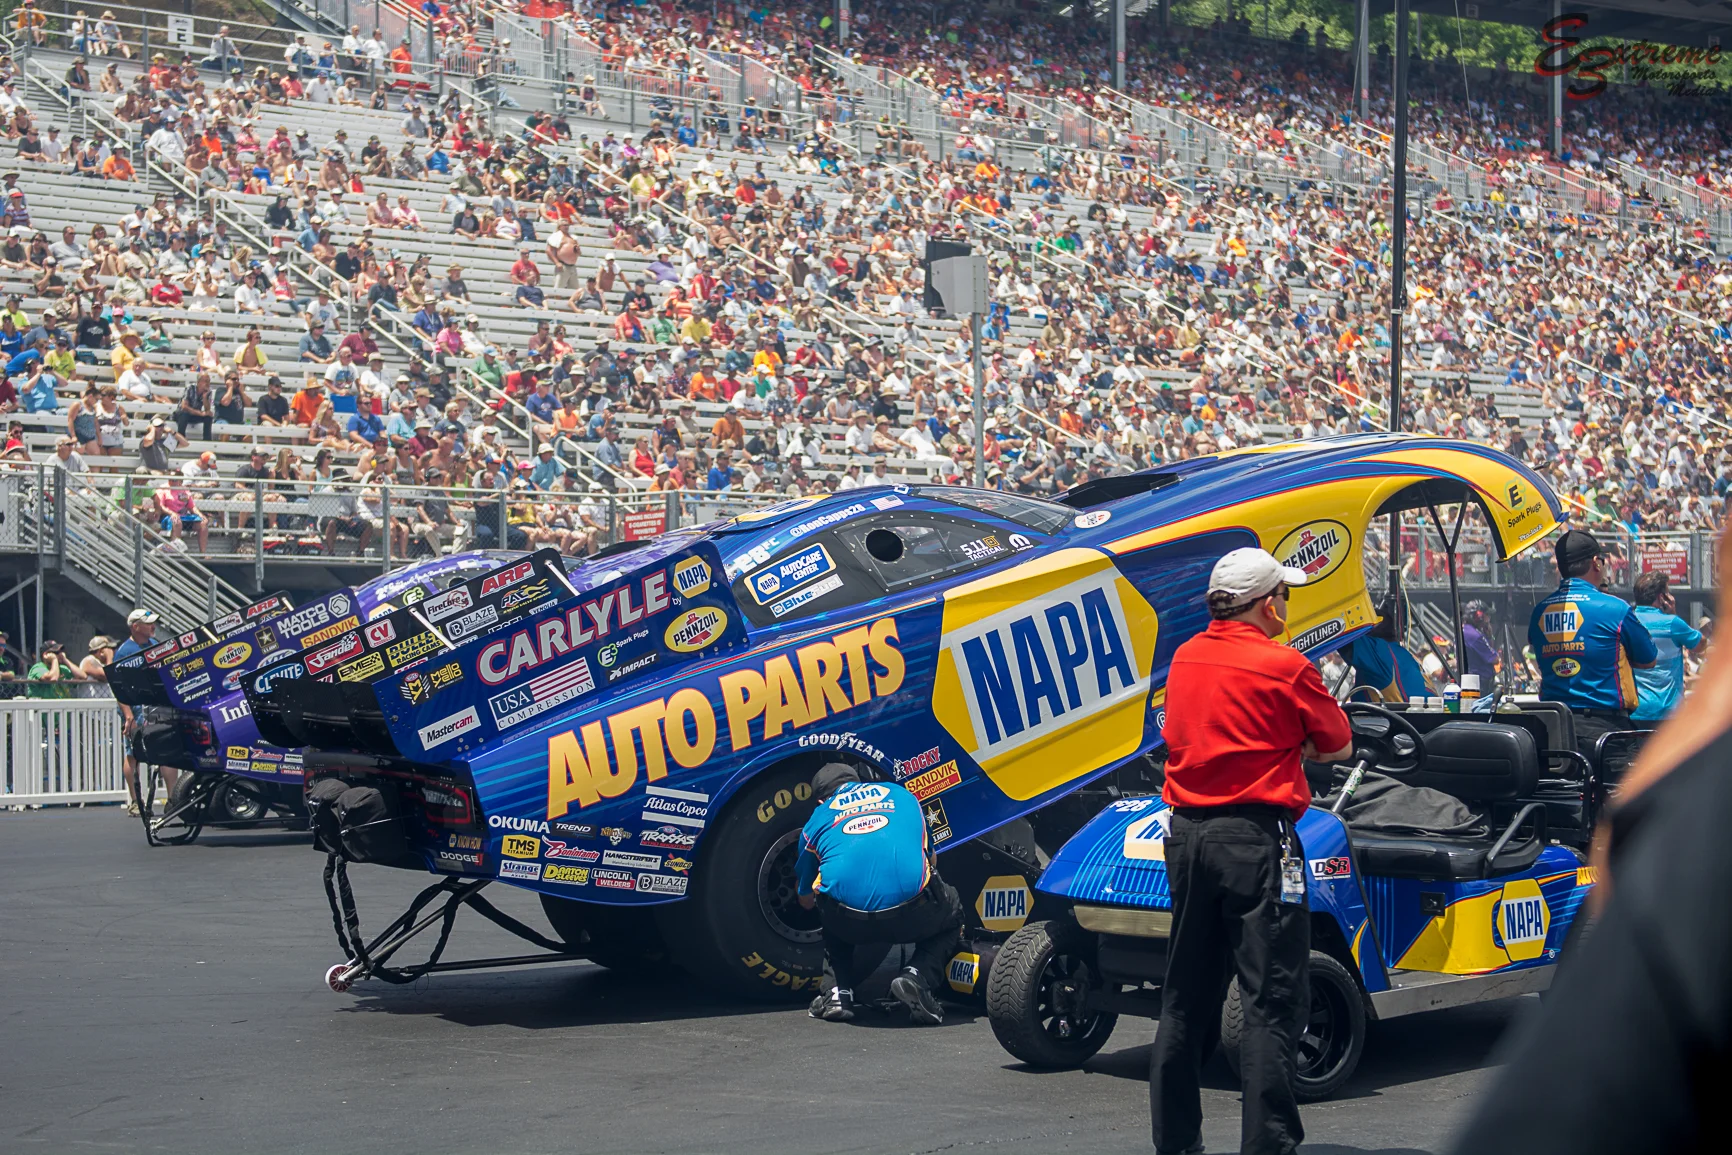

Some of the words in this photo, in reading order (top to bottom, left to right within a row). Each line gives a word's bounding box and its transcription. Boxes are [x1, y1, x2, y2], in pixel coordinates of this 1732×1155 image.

[1508, 513, 1526, 528] Spark
[1526, 502, 1542, 517] Plugs
[968, 546, 1004, 560] TACTICAL
[482, 562, 532, 595] ARP
[677, 564, 708, 590] NAPA
[793, 563, 819, 580] CENTER
[760, 577, 779, 592] NAPA
[248, 598, 277, 616] ARP
[672, 597, 682, 606] by
[276, 602, 327, 631] MATCO
[280, 613, 330, 639] TOOLS
[462, 607, 494, 627] BLAZE
[1545, 613, 1576, 632] NAPA
[304, 617, 358, 648] SANDVIK
[370, 624, 389, 641] CV
[476, 568, 671, 686] CARLYLE
[673, 612, 719, 646] PENNZOIL
[184, 634, 195, 645] CV
[616, 636, 632, 648] Spark
[634, 629, 649, 641] Plugs
[1542, 643, 1560, 653] AUTO
[1561, 642, 1585, 651] PARTS
[218, 645, 246, 665] PENNZOIL
[397, 650, 420, 664] RACING
[422, 642, 441, 653] CAMS
[600, 643, 618, 666] E3
[622, 653, 657, 675] IMPACT
[961, 586, 1136, 746] NAPA
[256, 664, 302, 693] CLVITE
[719, 616, 906, 752] PARTS
[192, 686, 213, 700] IMPACT
[495, 690, 531, 714] USA
[498, 680, 594, 729] COMPRESSION
[426, 714, 473, 743] Mastercam
[231, 748, 246, 756] TMS
[547, 687, 717, 822] AUTO
[798, 732, 885, 762] GOODYEAR
[902, 746, 941, 776] ROCKY
[907, 762, 957, 793] SANDVIK
[838, 786, 882, 806] NAPA
[920, 778, 951, 798] Coromant
[643, 797, 676, 812] Atlas
[676, 801, 708, 817] Copco
[834, 806, 859, 822] AUTO
[861, 801, 895, 812] PARTS
[488, 815, 550, 834] OKUMA
[556, 822, 591, 832] TREND
[848, 816, 883, 832] PENNZOIL
[507, 838, 535, 852] TMS
[639, 831, 696, 845] TRAXXAS
[936, 830, 950, 840] ARMY
[440, 852, 479, 863] DODGE
[666, 860, 692, 869] SUNOCO
[1315, 858, 1348, 876] DSR
[558, 873, 587, 882] SLEEVES
[593, 871, 630, 880] LINCOLN
[600, 879, 631, 888] WELDERS
[654, 877, 686, 887] BLAZE
[985, 890, 1025, 917] NAPA
[1505, 900, 1544, 940] NAPA
[950, 960, 974, 984] NAPA
